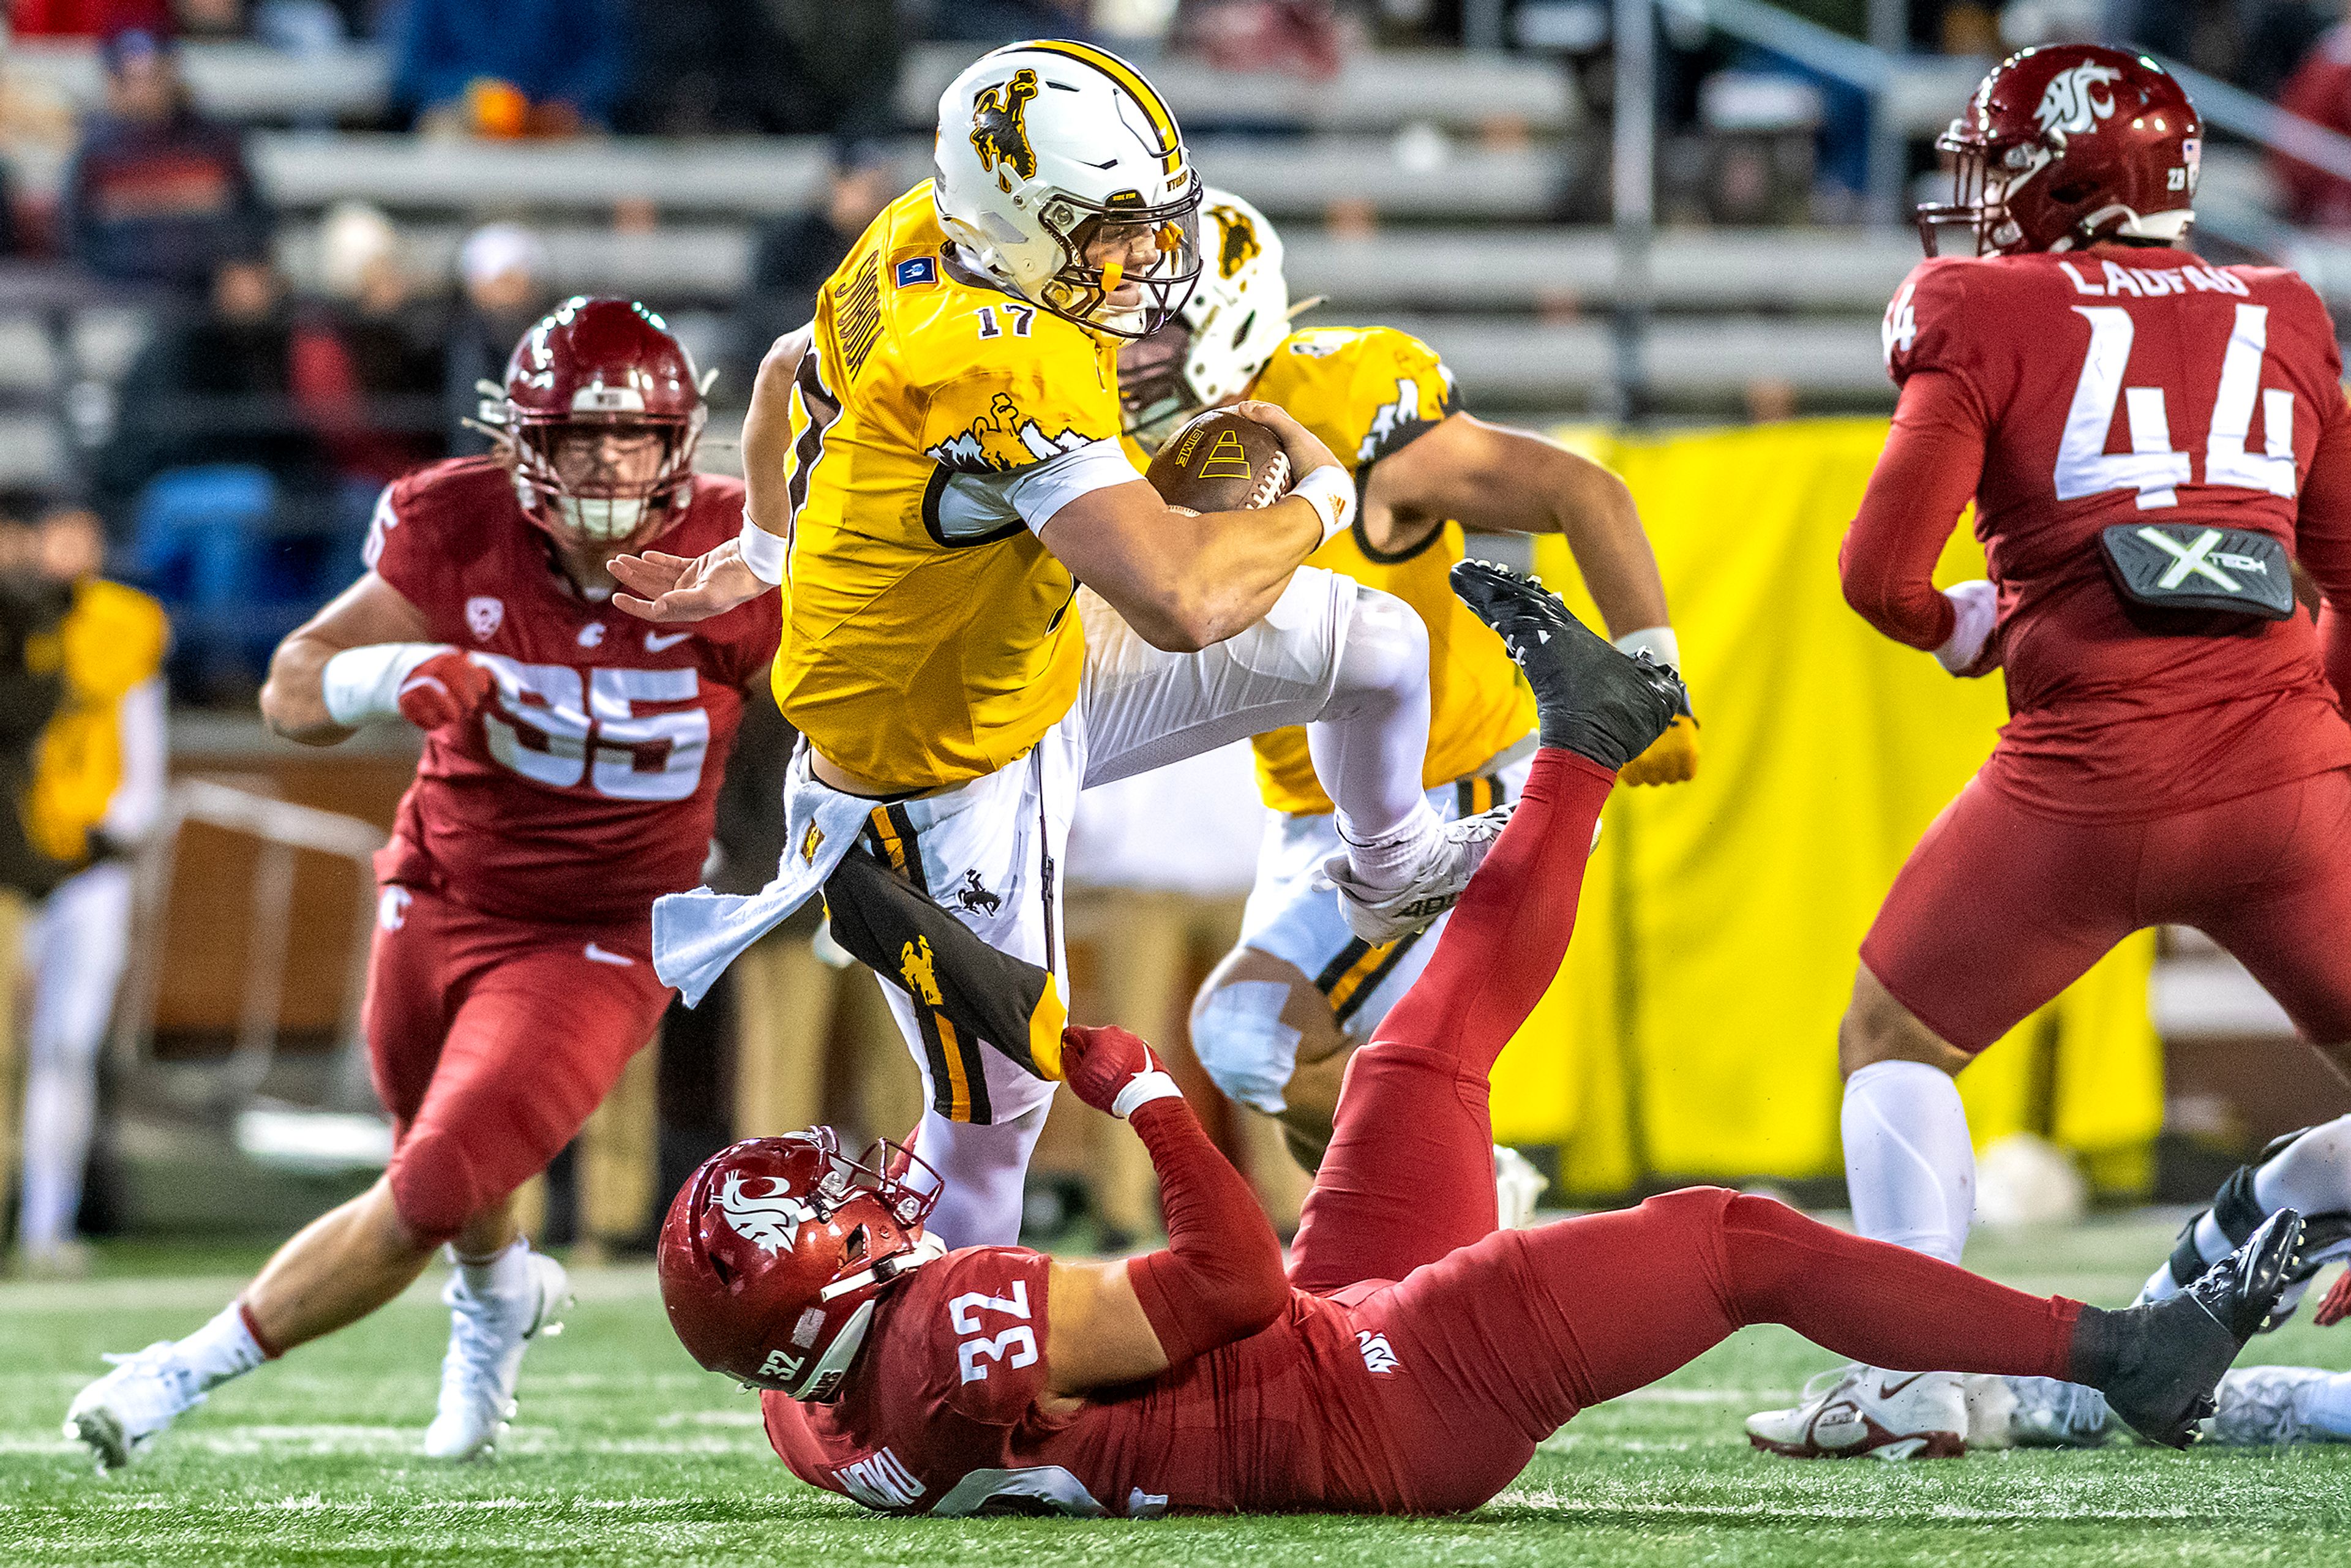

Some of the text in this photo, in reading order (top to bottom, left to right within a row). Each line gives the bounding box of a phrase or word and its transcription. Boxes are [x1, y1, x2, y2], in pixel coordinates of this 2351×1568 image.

[974, 304, 1038, 340] 17
[2054, 303, 2297, 510] 44
[1175, 428, 1205, 467] DIME
[470, 650, 708, 801] 95
[757, 1349, 806, 1381] 32
[950, 1280, 1039, 1387] 32
